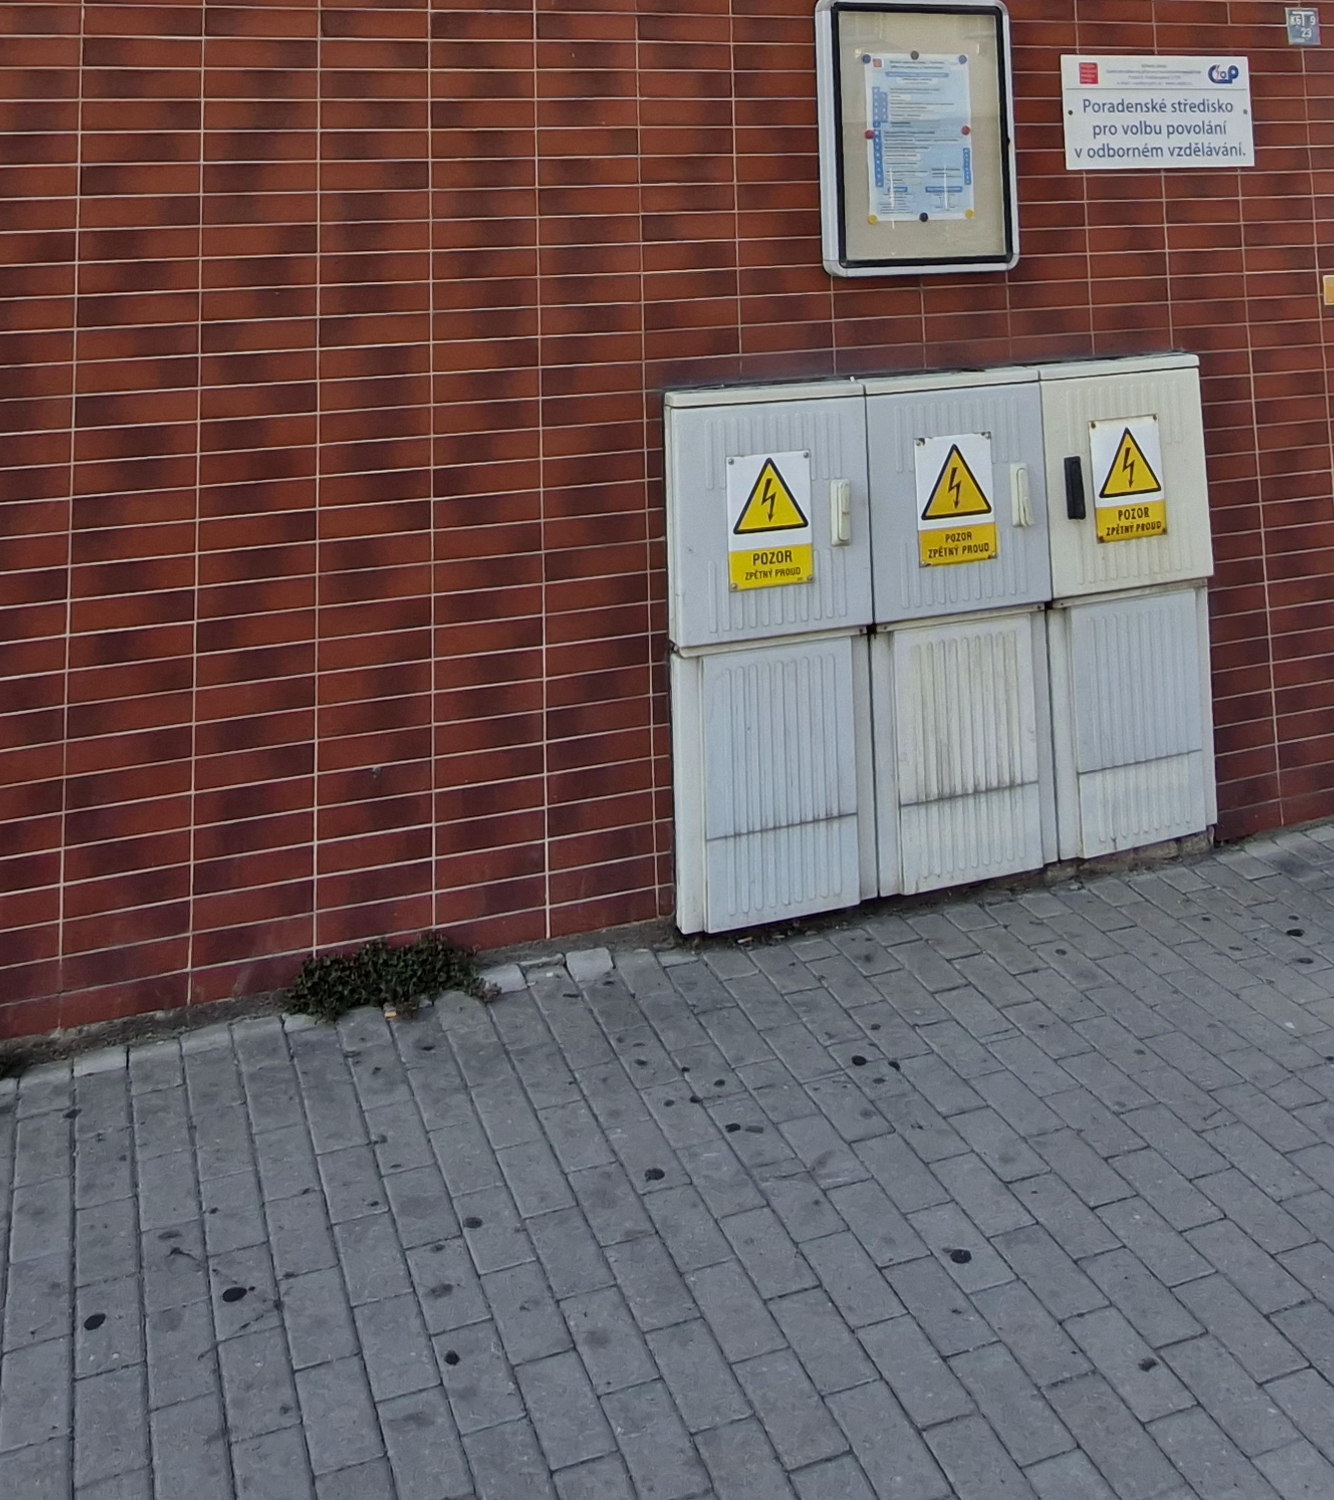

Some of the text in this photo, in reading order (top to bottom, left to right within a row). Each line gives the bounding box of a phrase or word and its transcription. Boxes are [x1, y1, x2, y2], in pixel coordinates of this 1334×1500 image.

[1083, 98, 1233, 113] Poradenské středisko
[1092, 120, 1226, 139] pro volbu povolání
[1074, 142, 1246, 158] v odborném vzdělávání.
[1118, 507, 1150, 521] POZOR
[1136, 521, 1161, 532] PROUD
[945, 531, 972, 542] POZOR
[962, 542, 989, 555] PROUD
[753, 550, 792, 566] POZOR
[775, 567, 801, 578] PROUD
